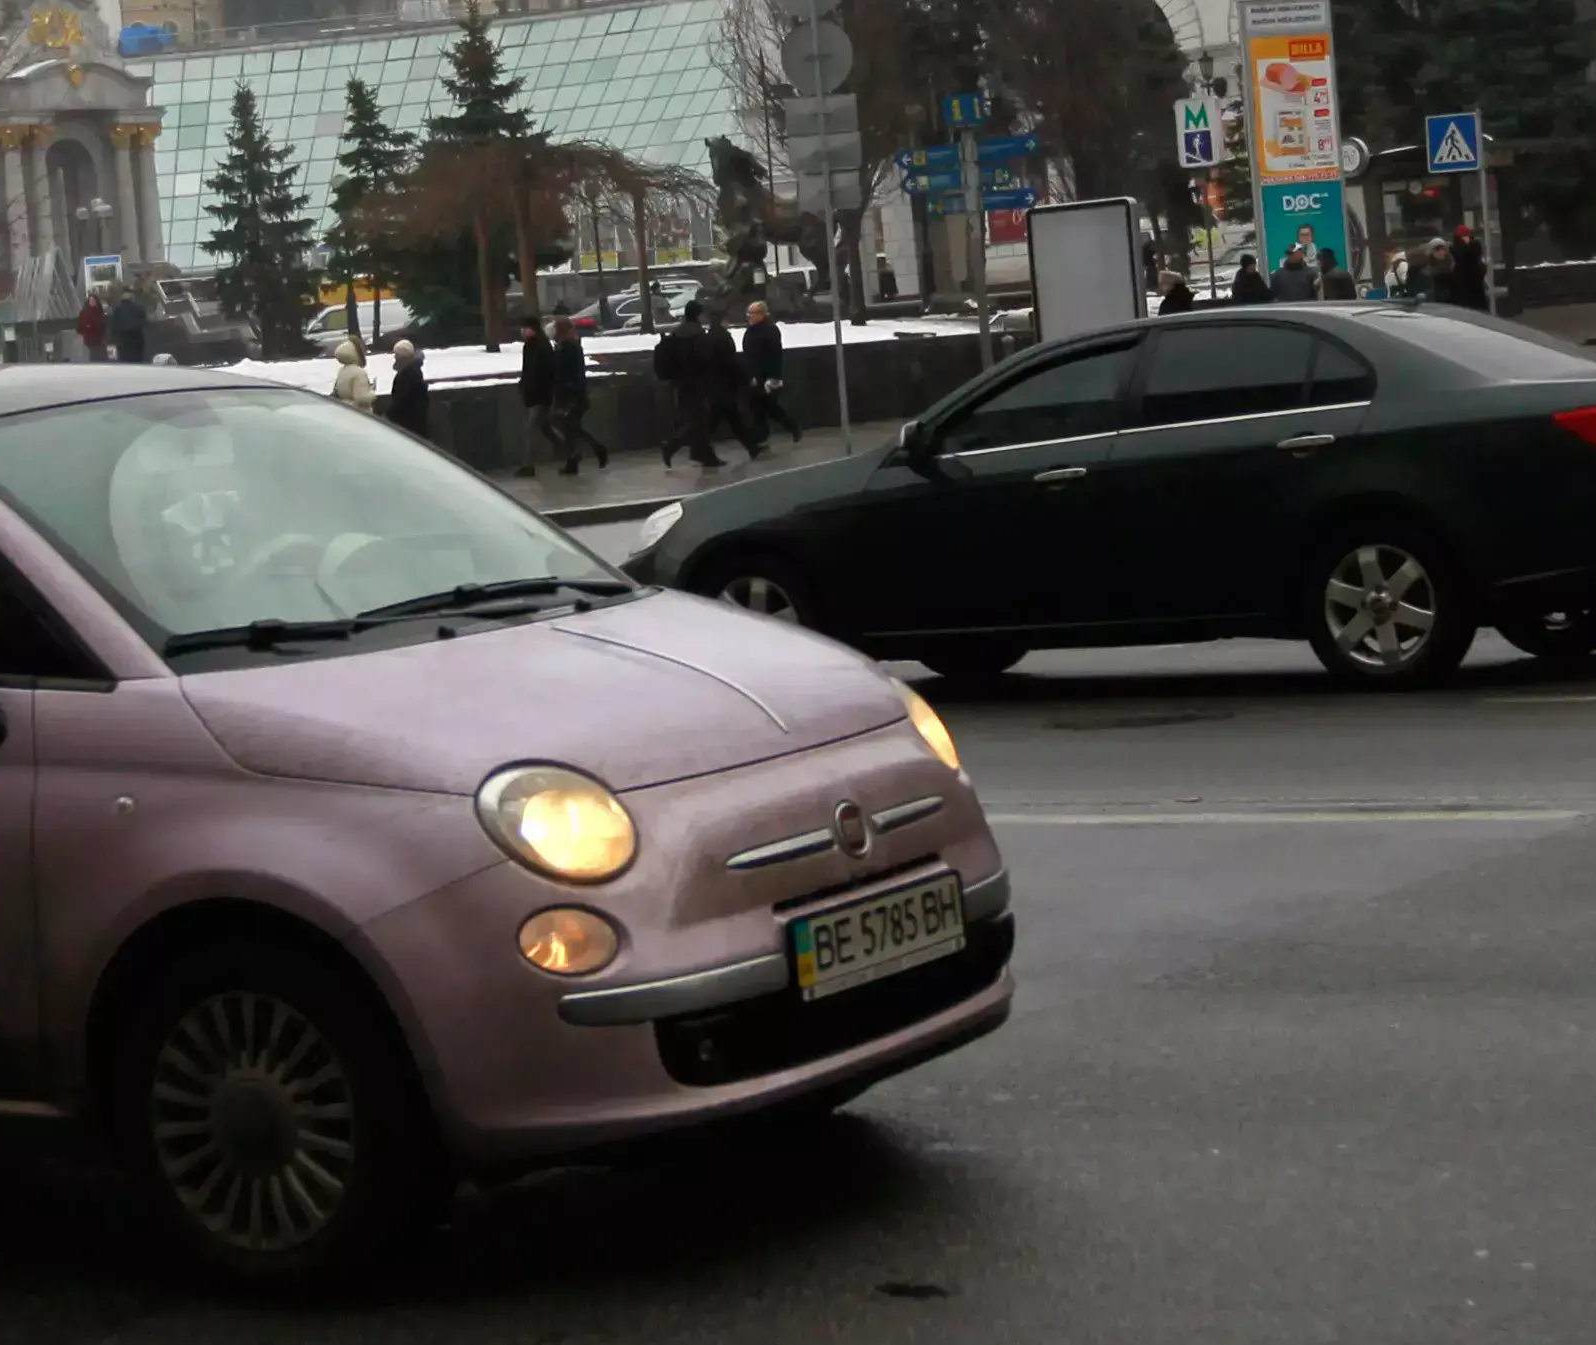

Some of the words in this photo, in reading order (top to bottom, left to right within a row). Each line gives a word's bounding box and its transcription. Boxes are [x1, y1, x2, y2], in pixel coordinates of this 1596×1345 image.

[1185, 103, 1209, 129] M
[814, 917, 855, 970] BE
[859, 897, 918, 956] 5785
[920, 883, 959, 936] BH
